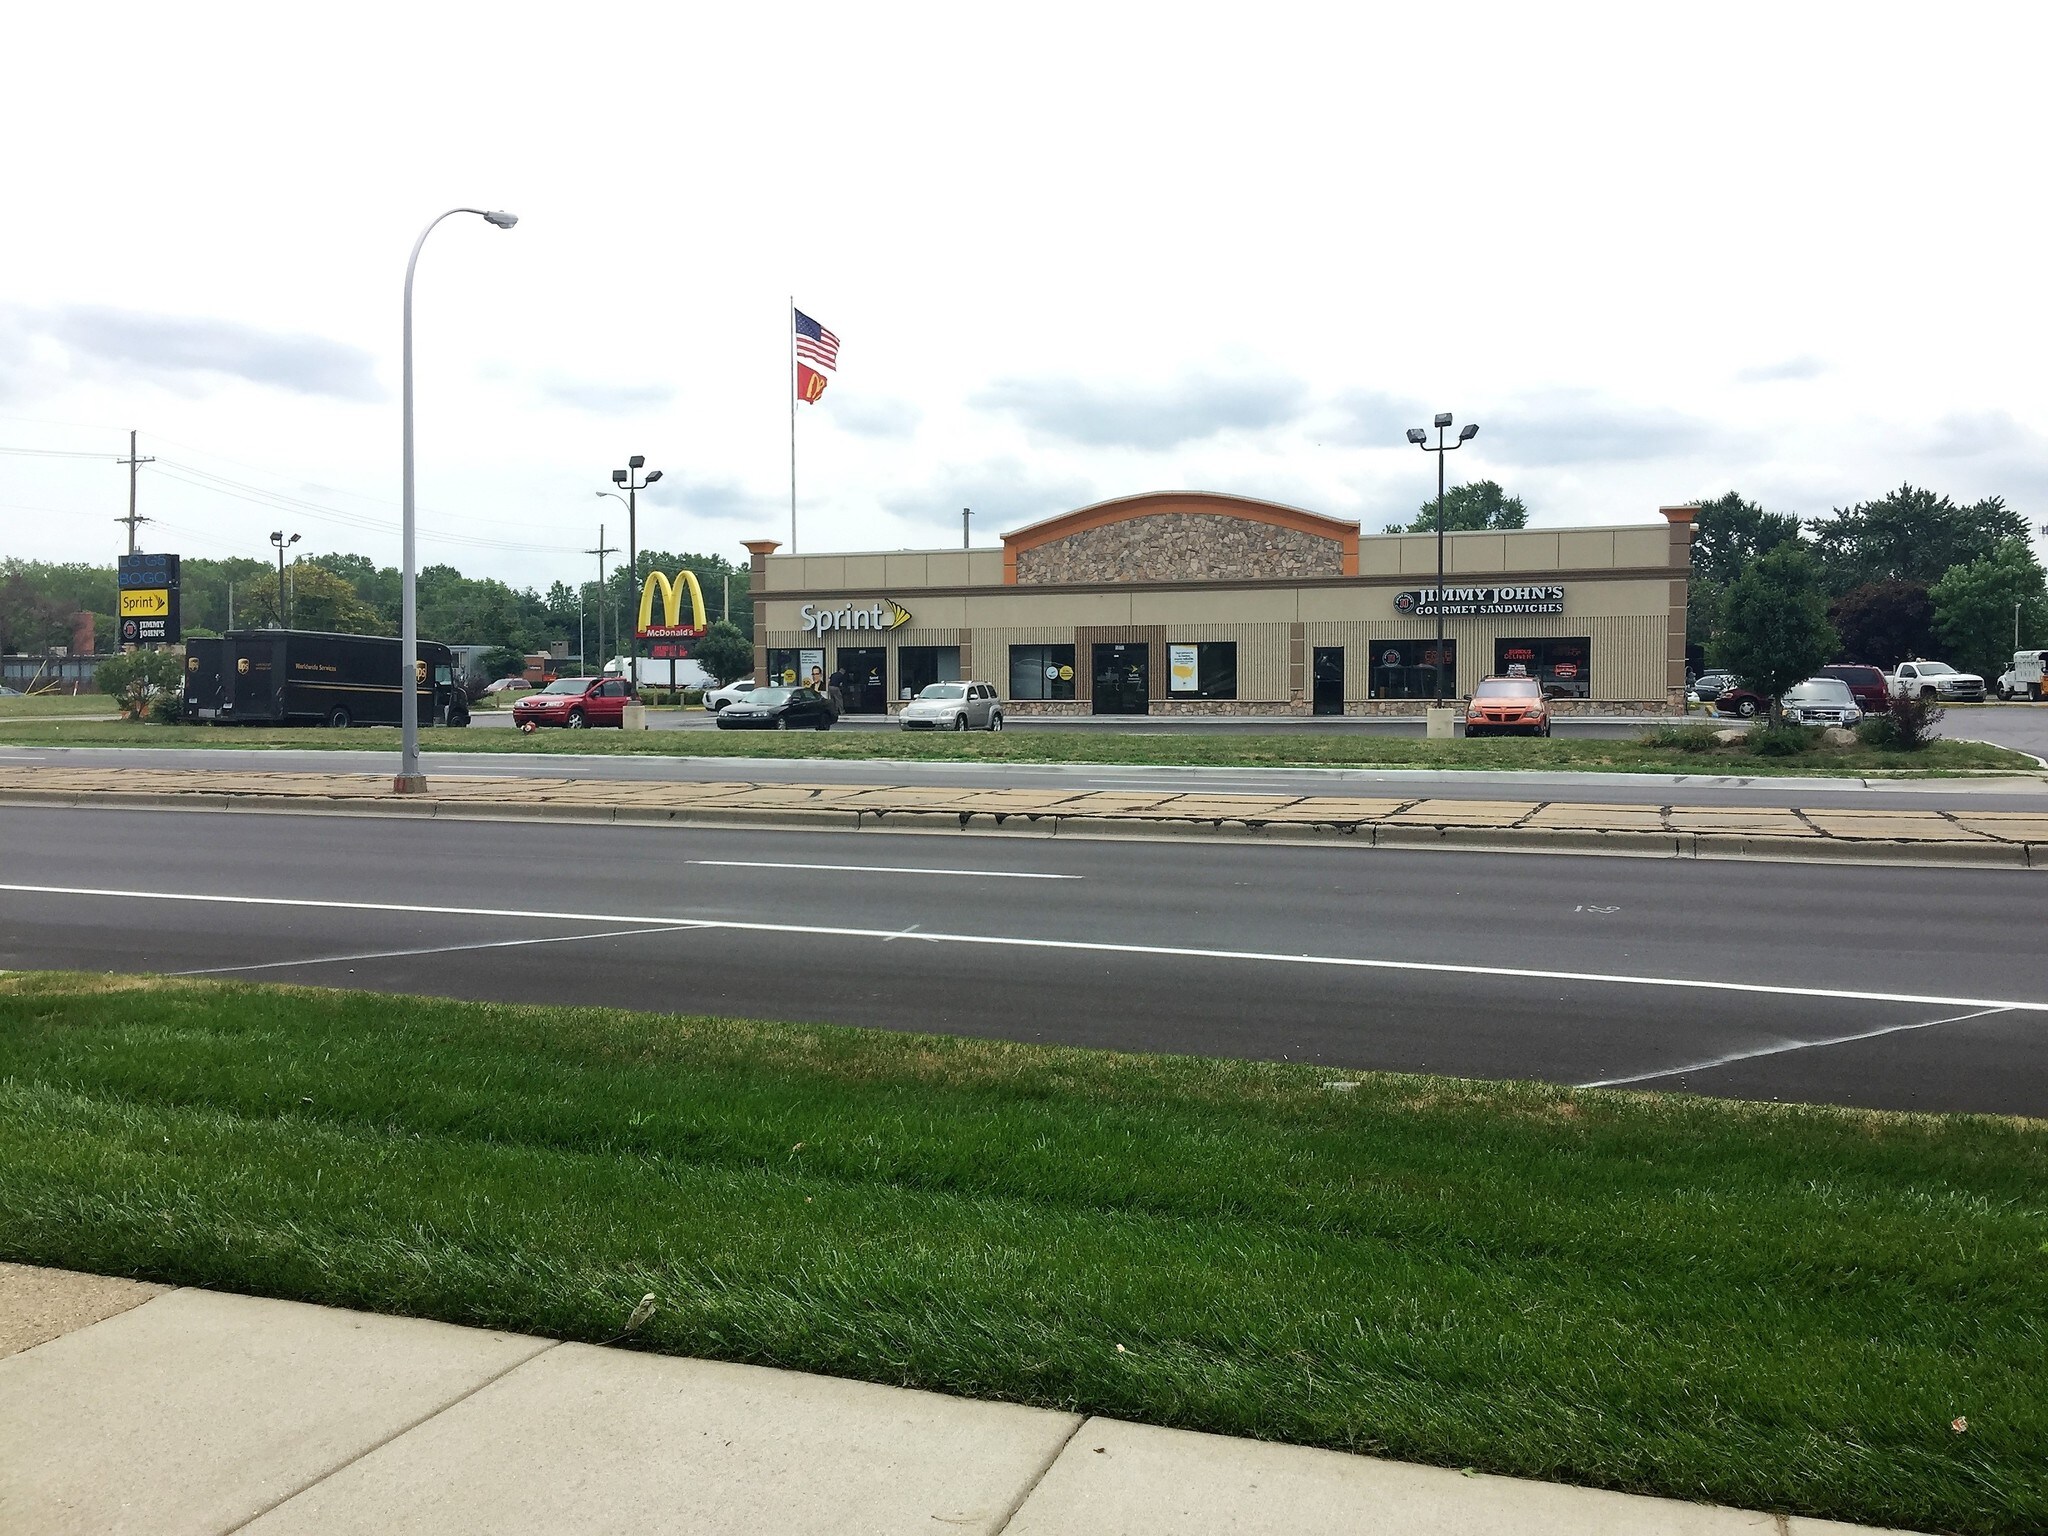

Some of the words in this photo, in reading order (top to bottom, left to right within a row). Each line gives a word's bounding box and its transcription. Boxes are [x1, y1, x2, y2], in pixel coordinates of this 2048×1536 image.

[119, 572, 167, 585] BOGO
[1419, 587, 1488, 606] JIMMY
[1492, 585, 1564, 604] JOHN'S
[123, 596, 153, 611] Sprint
[1415, 604, 1477, 616] GOURMET
[1479, 603, 1563, 615] SANDWICHES
[139, 620, 165, 629] JIMMY
[800, 602, 884, 638] Sprint
[139, 629, 165, 638] JOHN'S
[646, 628, 694, 638] McDonald's
